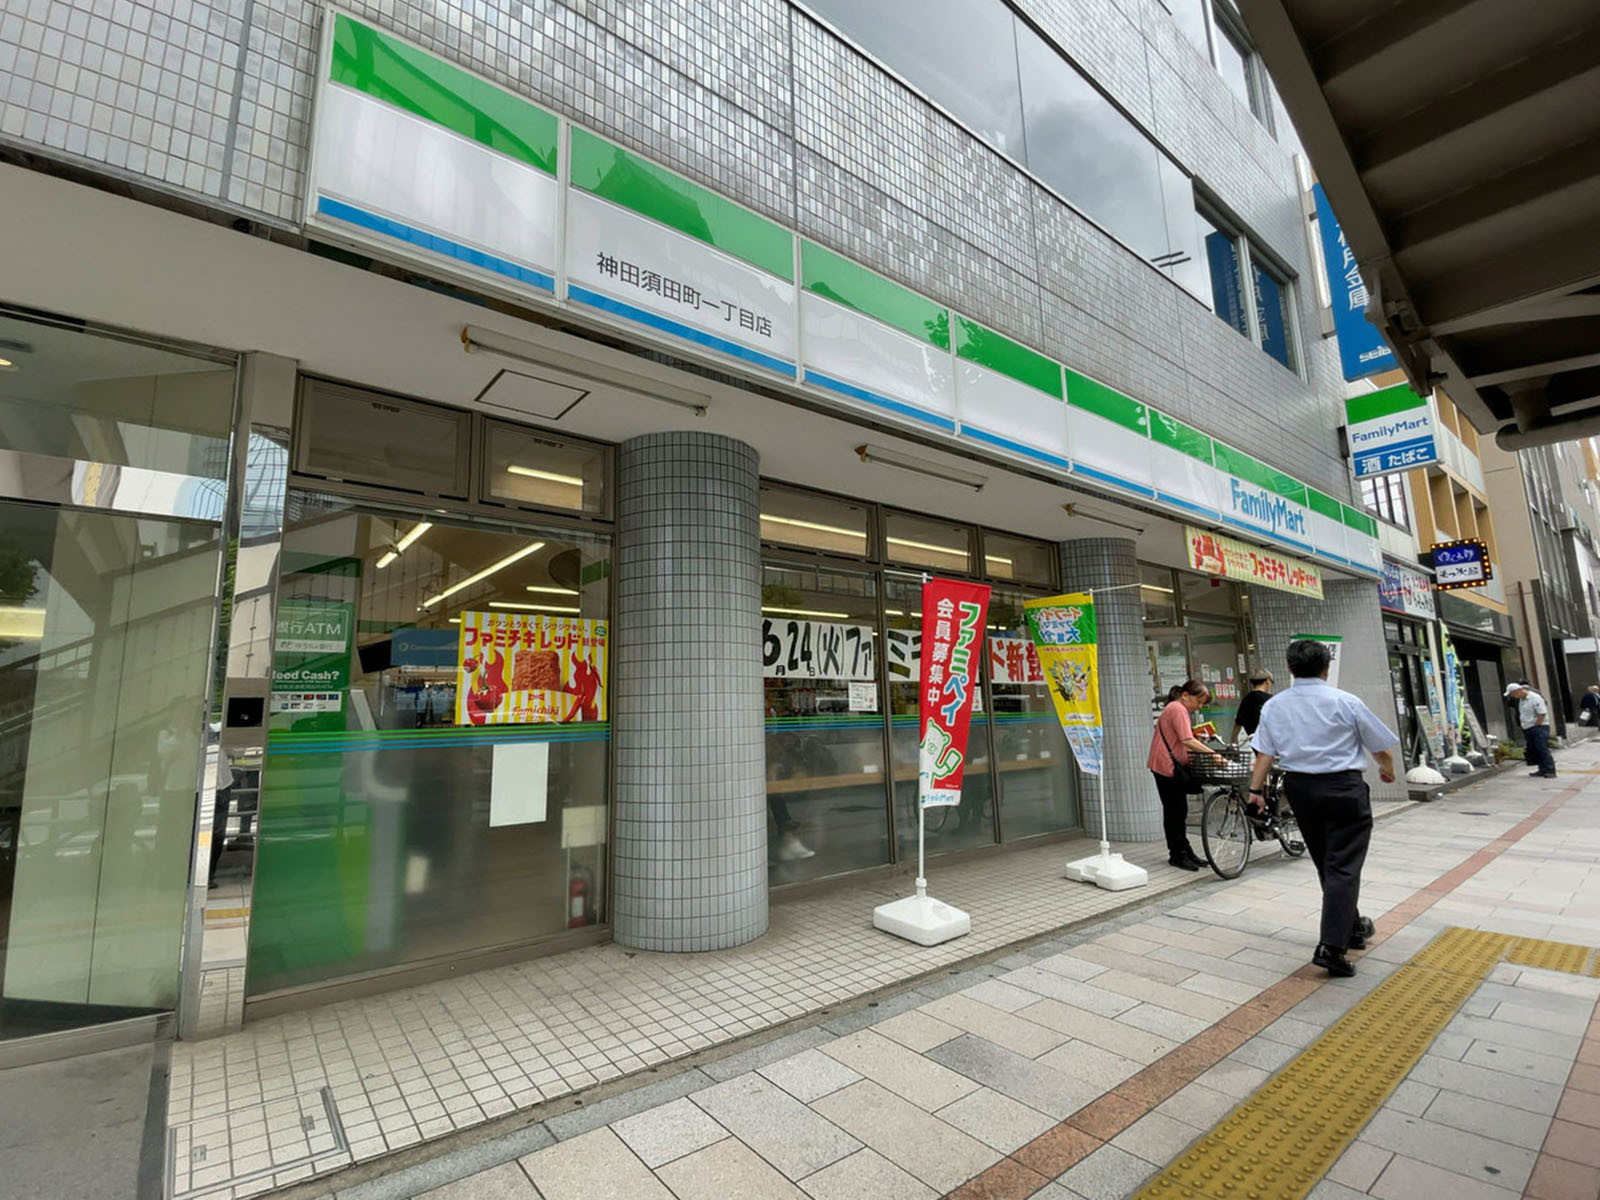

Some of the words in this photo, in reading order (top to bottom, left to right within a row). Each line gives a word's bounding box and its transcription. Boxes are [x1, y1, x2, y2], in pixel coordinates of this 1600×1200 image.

[596, 252, 772, 338] 神田須田町一丁目店
[1352, 417, 1429, 443] FamilyMart
[1361, 456, 1382, 474] 酒
[1388, 447, 1430, 467] たばこ
[1230, 478, 1306, 535] FamilyMart
[464, 627, 581, 650] ファミチキレッド
[927, 598, 954, 707] 会員募集中
[301, 670, 340, 680] Cash?
[941, 601, 981, 727] ファミペイ
